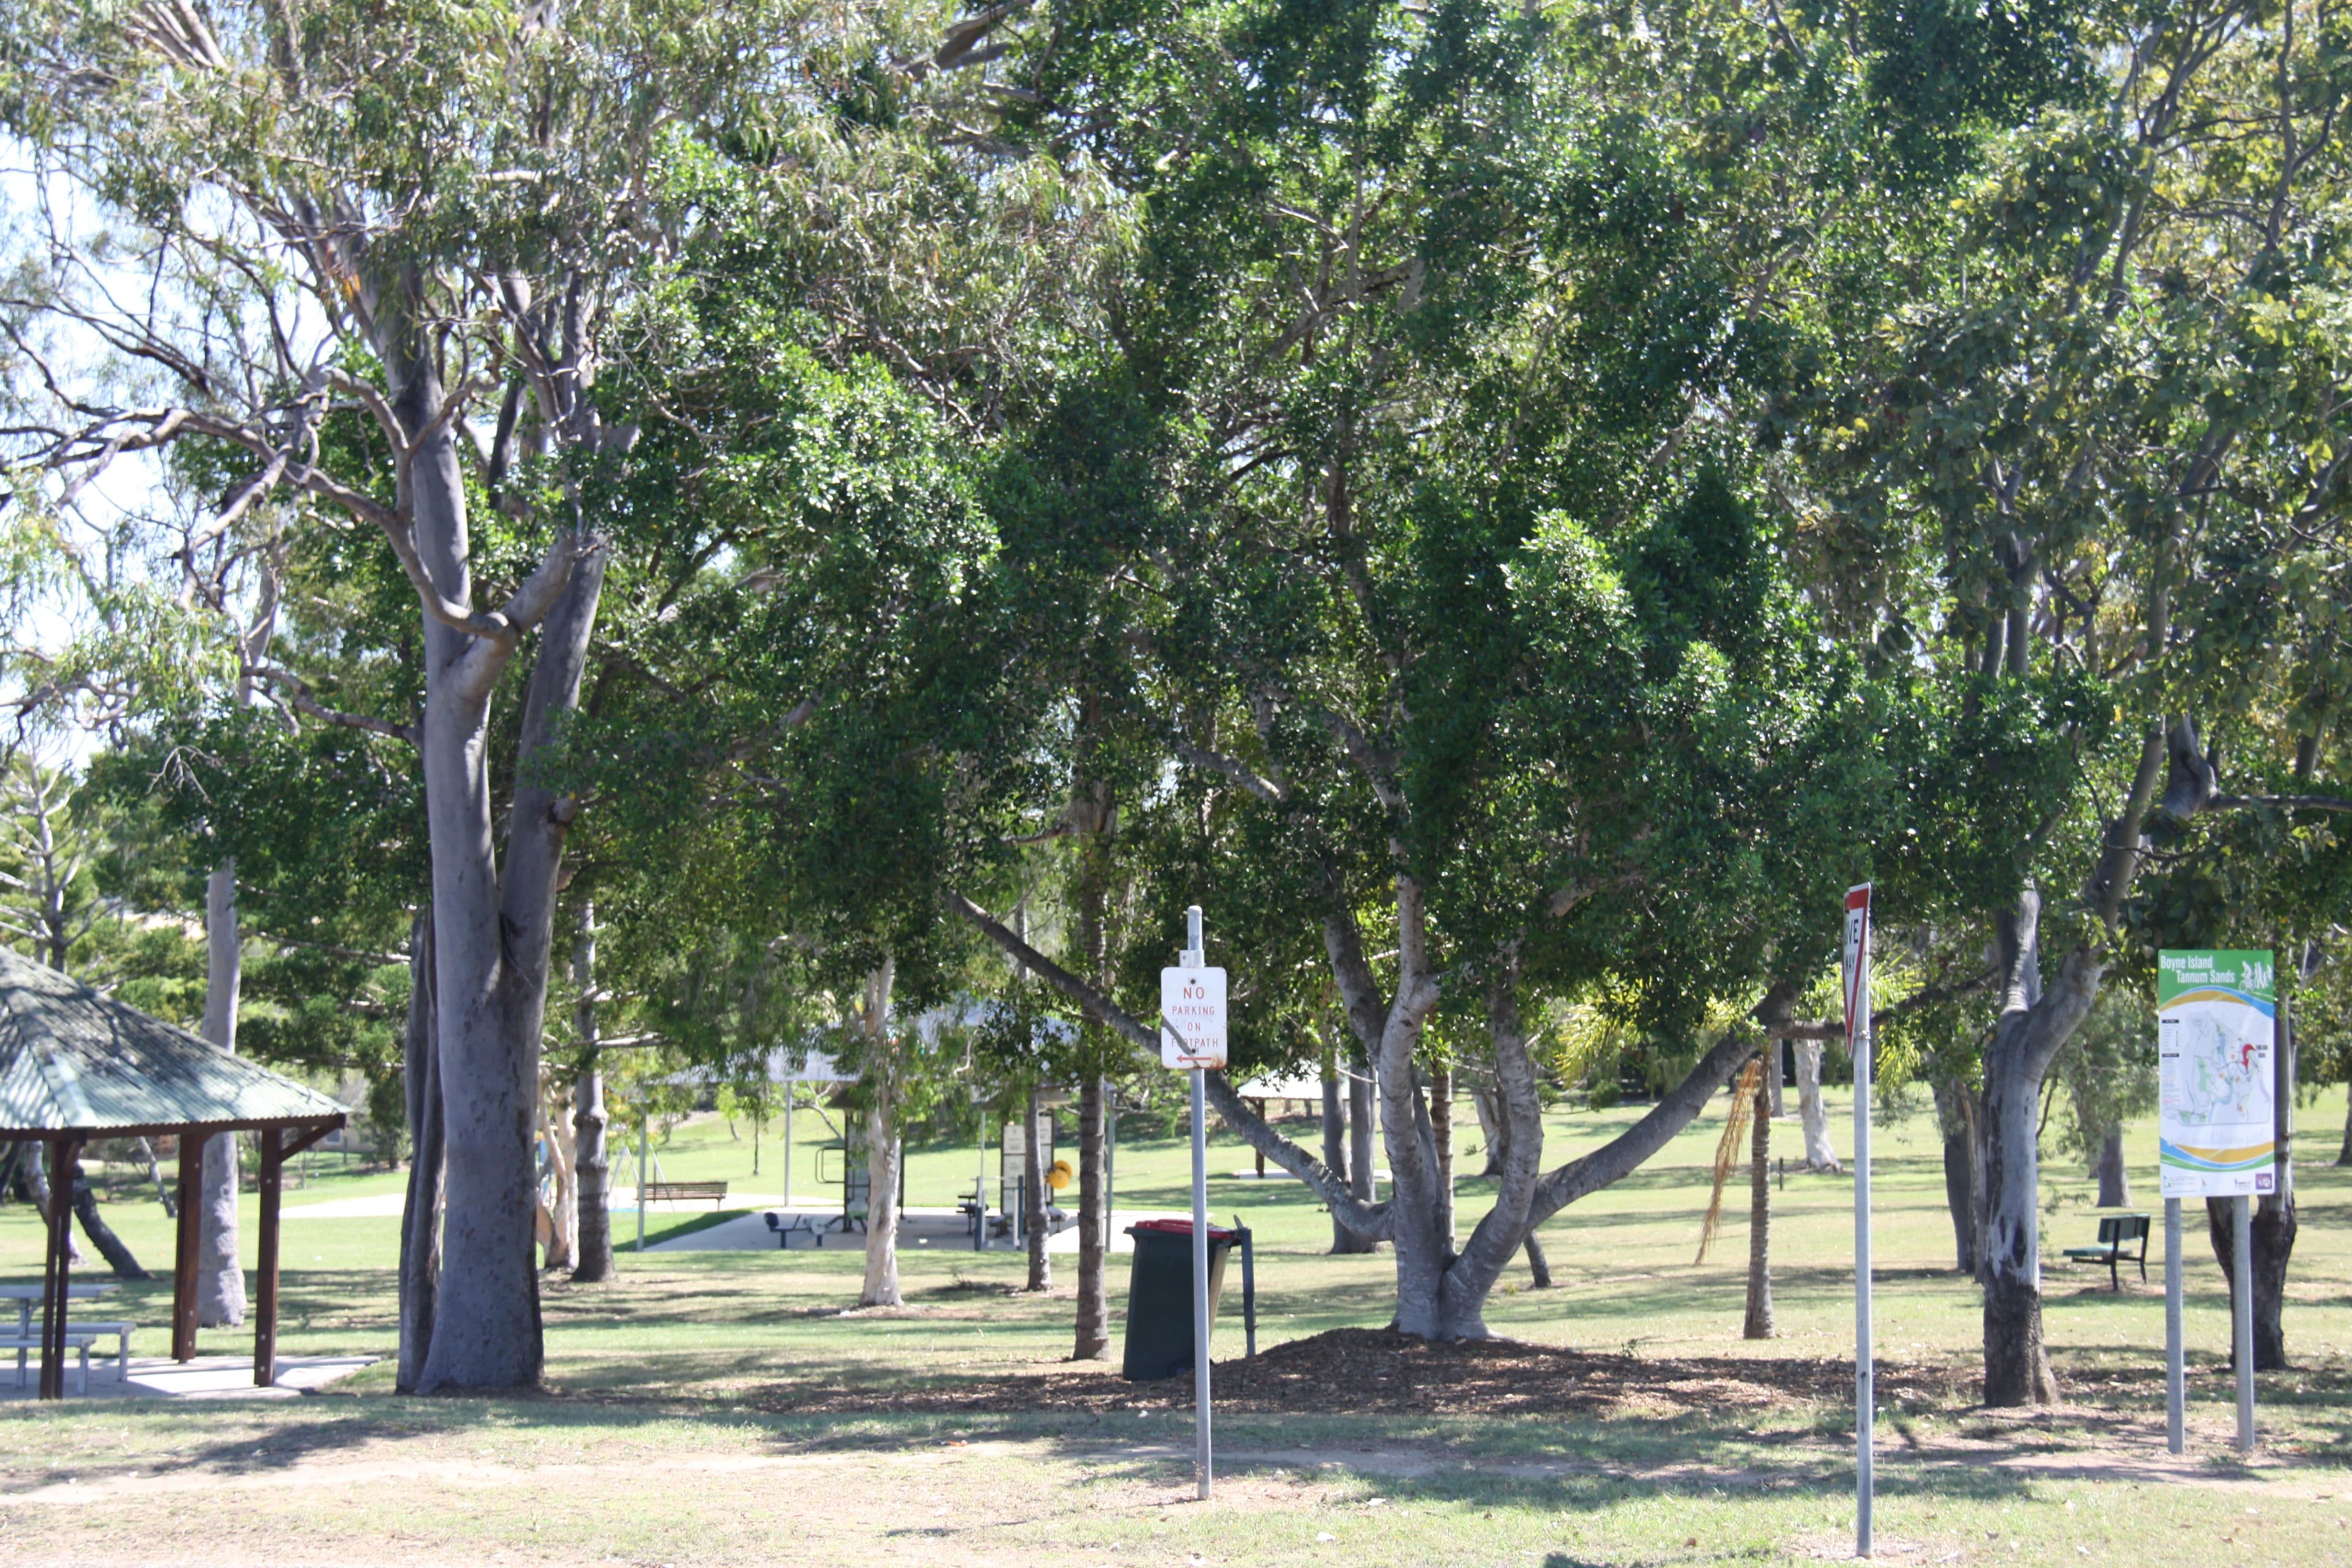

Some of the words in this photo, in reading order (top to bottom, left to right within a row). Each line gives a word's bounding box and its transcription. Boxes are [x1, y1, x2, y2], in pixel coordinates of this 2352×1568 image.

[2160, 956, 2185, 971] Boyne
[2188, 956, 2213, 969] Island
[2176, 970, 2208, 983] Tannum
[2210, 970, 2235, 982] Sands
[1183, 987, 1205, 999] NO
[1172, 1006, 1215, 1015] PARKING
[1188, 1022, 1200, 1031] ON
[1172, 1038, 1218, 1047] FTPATH
